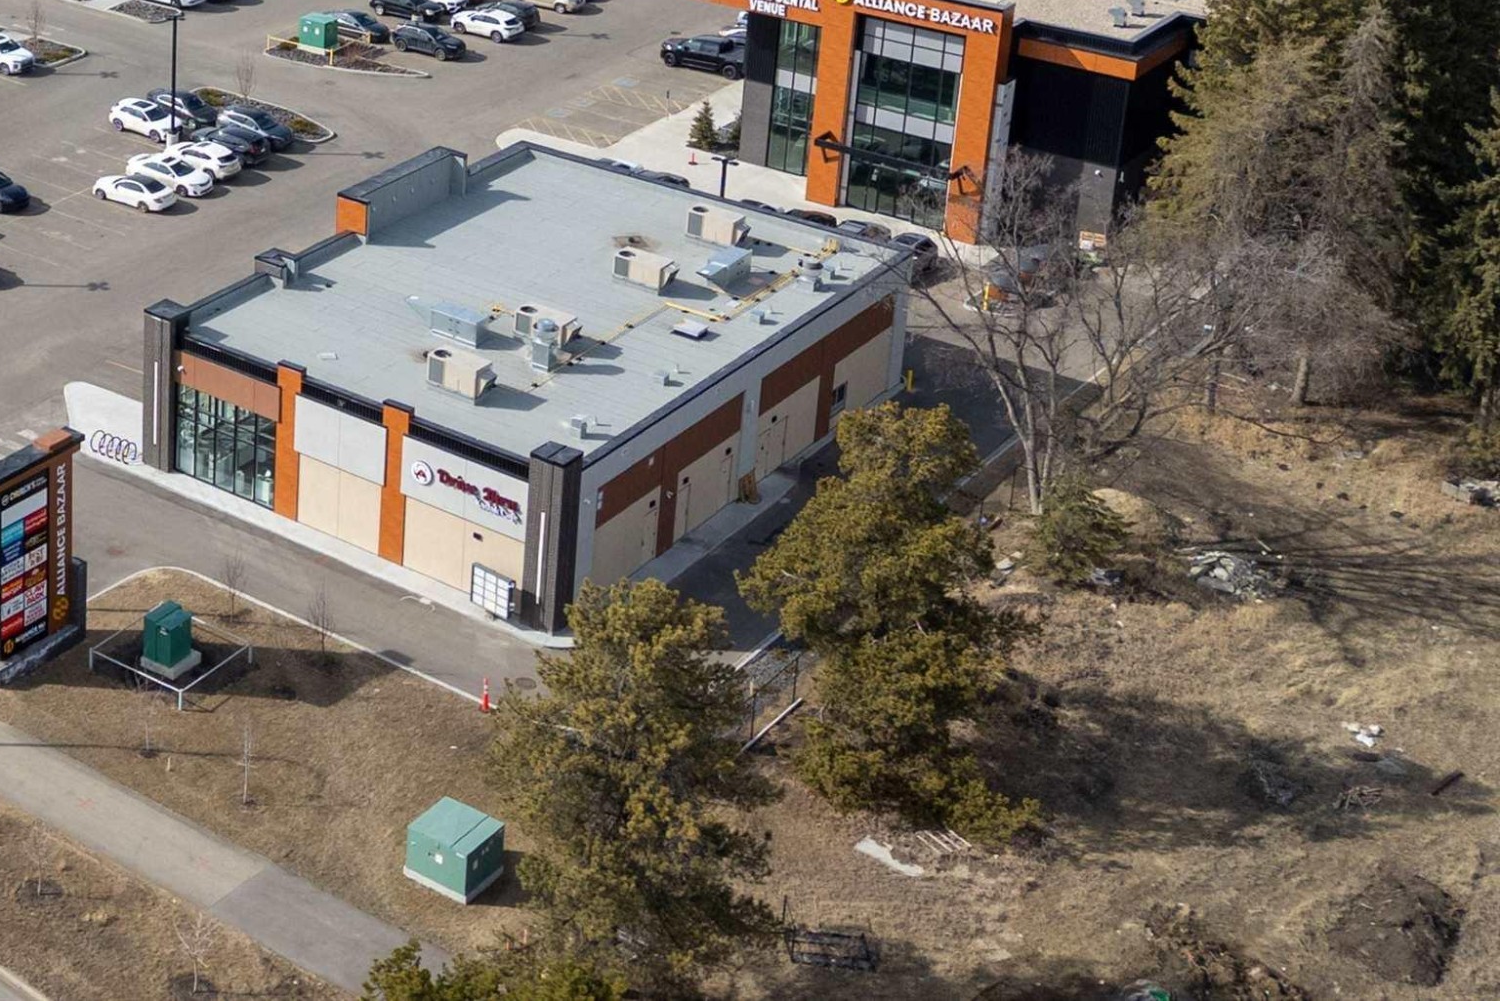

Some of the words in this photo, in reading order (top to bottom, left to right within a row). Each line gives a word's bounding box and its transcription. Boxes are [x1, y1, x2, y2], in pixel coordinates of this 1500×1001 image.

[929, 8, 995, 34] BAZAAR
[56, 462, 66, 526] BAZAAR
[56, 527, 66, 595] ALLIANCE
